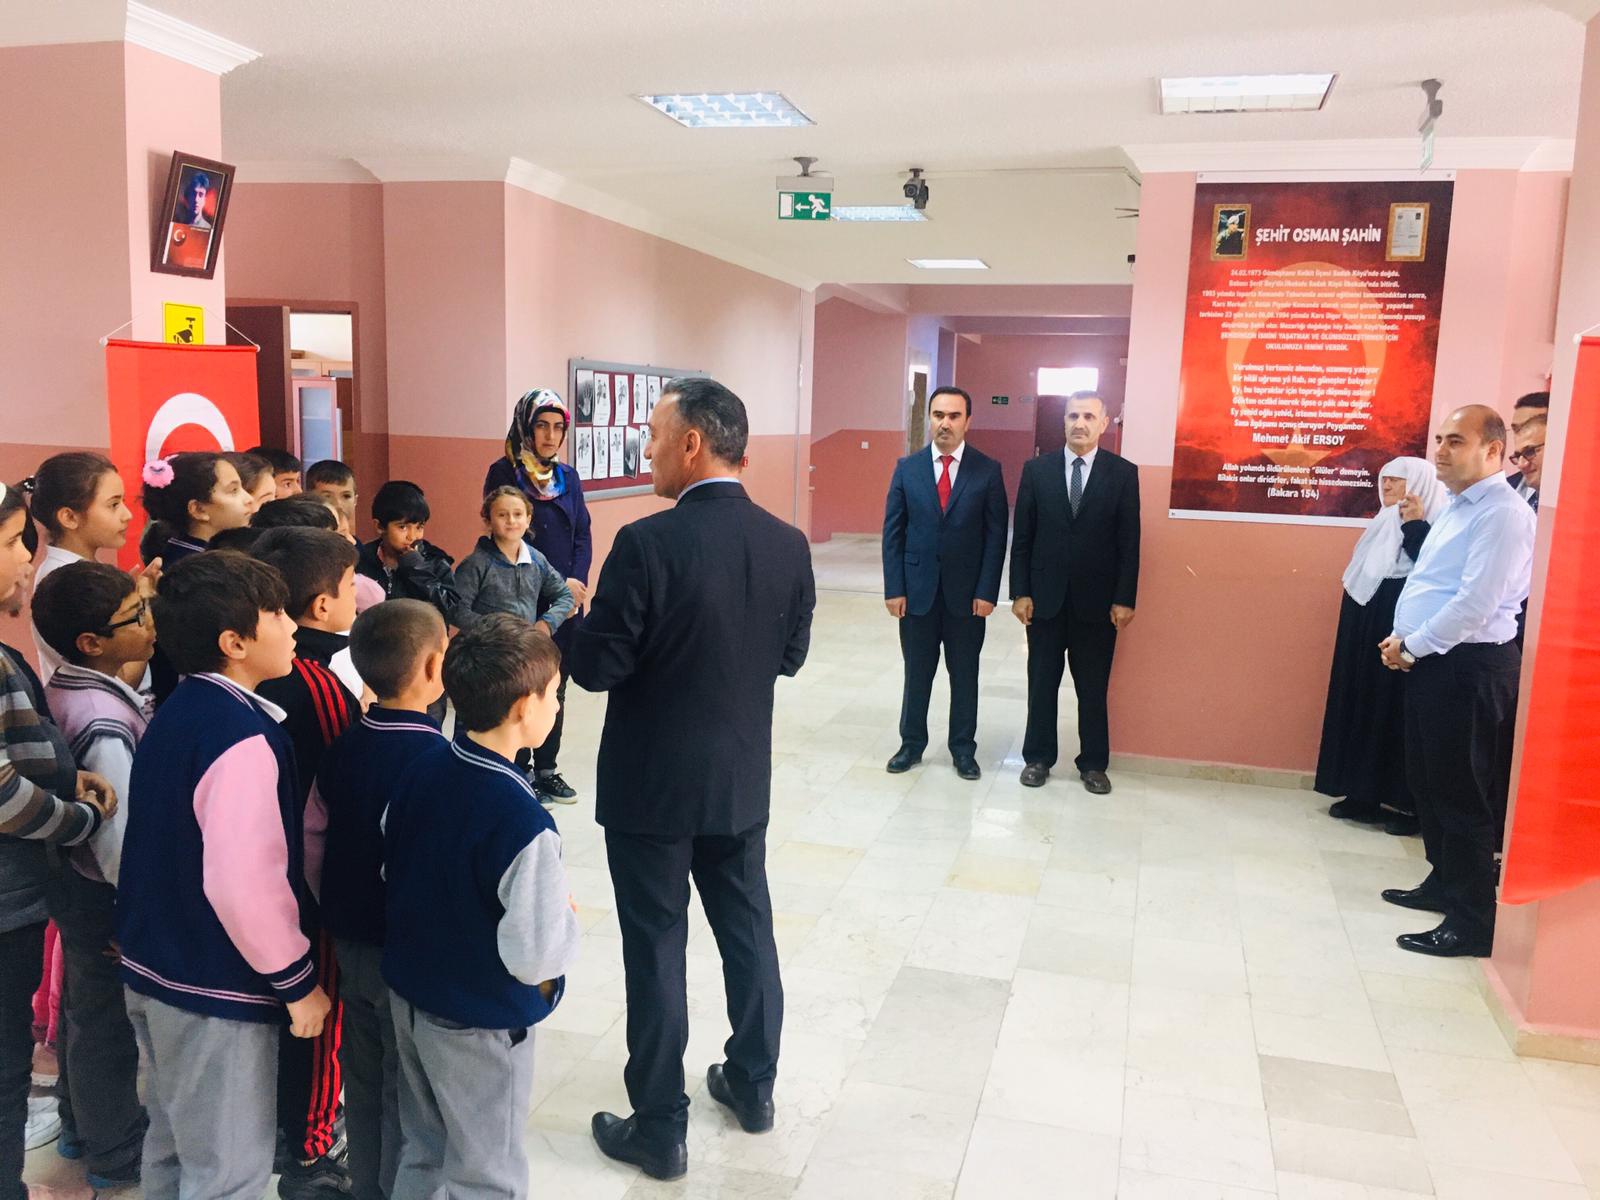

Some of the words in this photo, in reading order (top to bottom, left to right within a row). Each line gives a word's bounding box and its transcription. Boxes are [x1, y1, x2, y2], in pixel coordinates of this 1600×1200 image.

[1256, 224, 1291, 246] ŞEHİT
[1293, 228, 1340, 242] OSMAN
[1342, 224, 1381, 246] ŞAHİN
[1252, 433, 1289, 444] Mehmet
[1291, 434, 1311, 444] Akif
[1312, 434, 1345, 446] ERSOY
[1267, 487, 1299, 498] (Bakara
[1300, 488, 1320, 501] 154)
